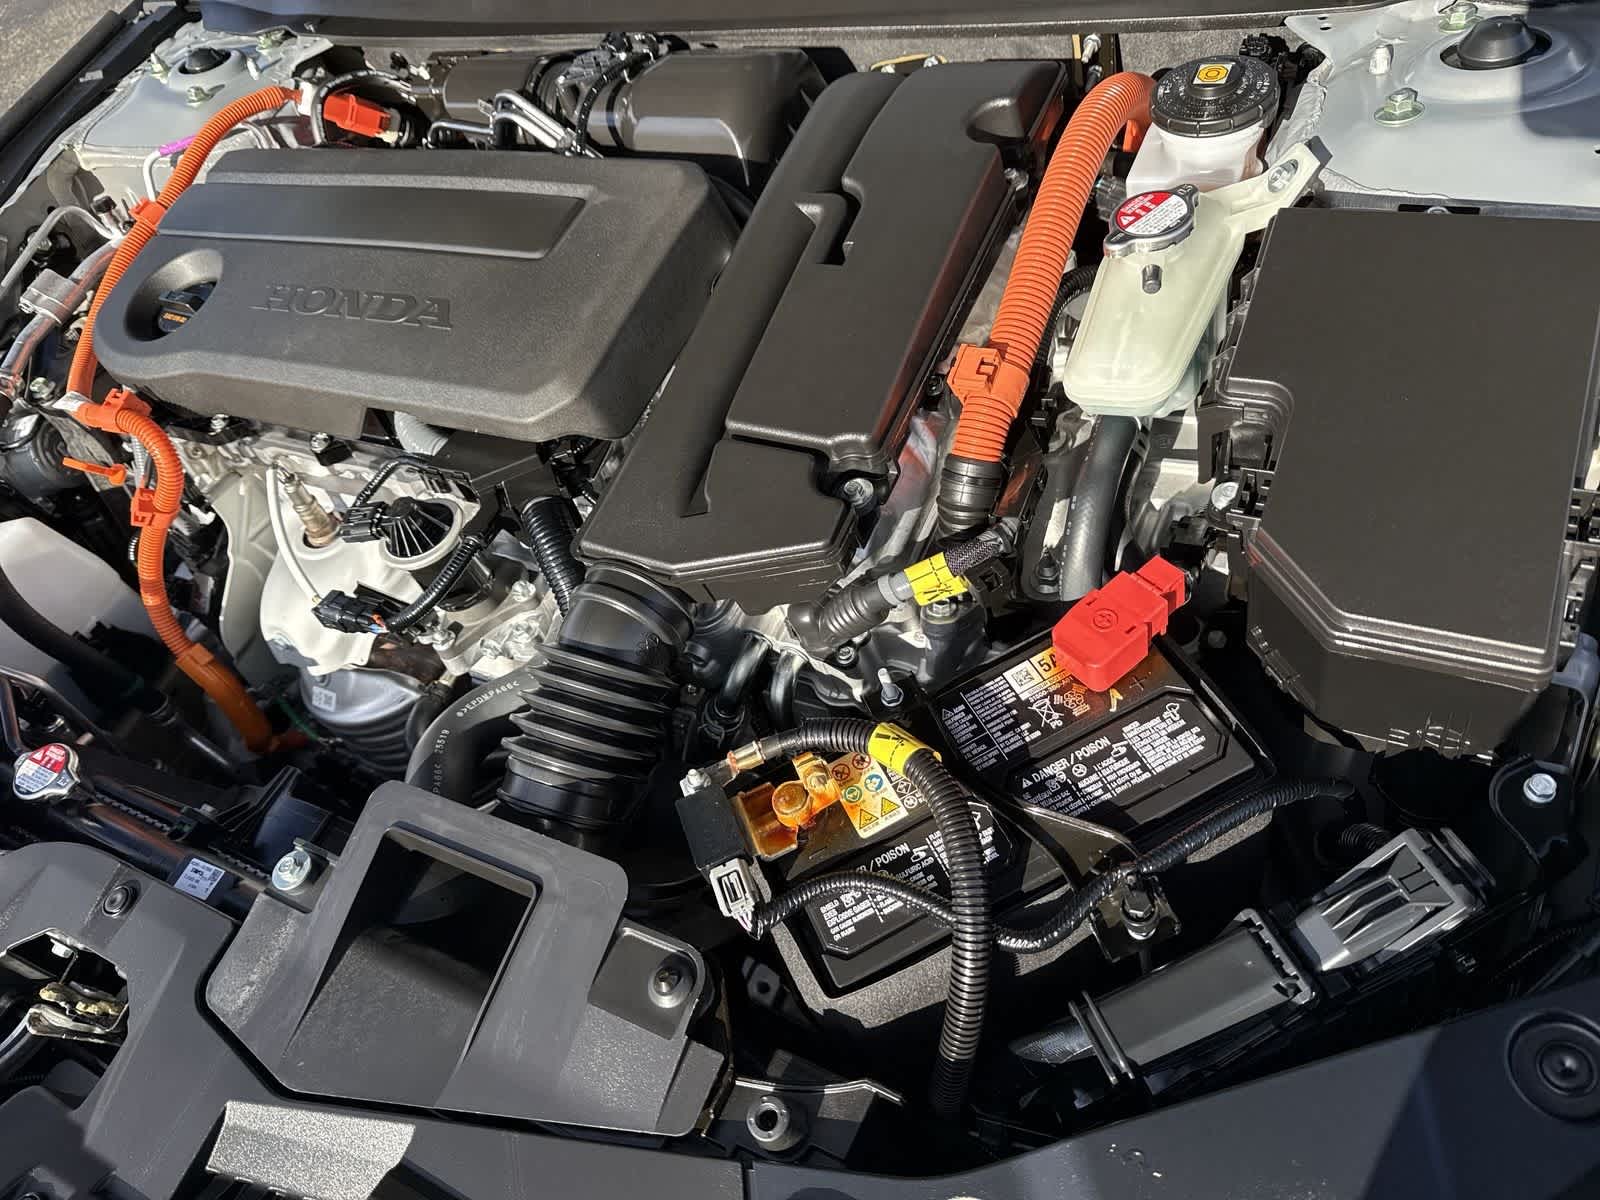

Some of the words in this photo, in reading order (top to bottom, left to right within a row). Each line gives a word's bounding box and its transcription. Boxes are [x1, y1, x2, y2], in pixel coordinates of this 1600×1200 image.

[249, 286, 450, 330] HONDA
[1048, 717, 1064, 729] Pb
[919, 856, 935, 868] ACID
